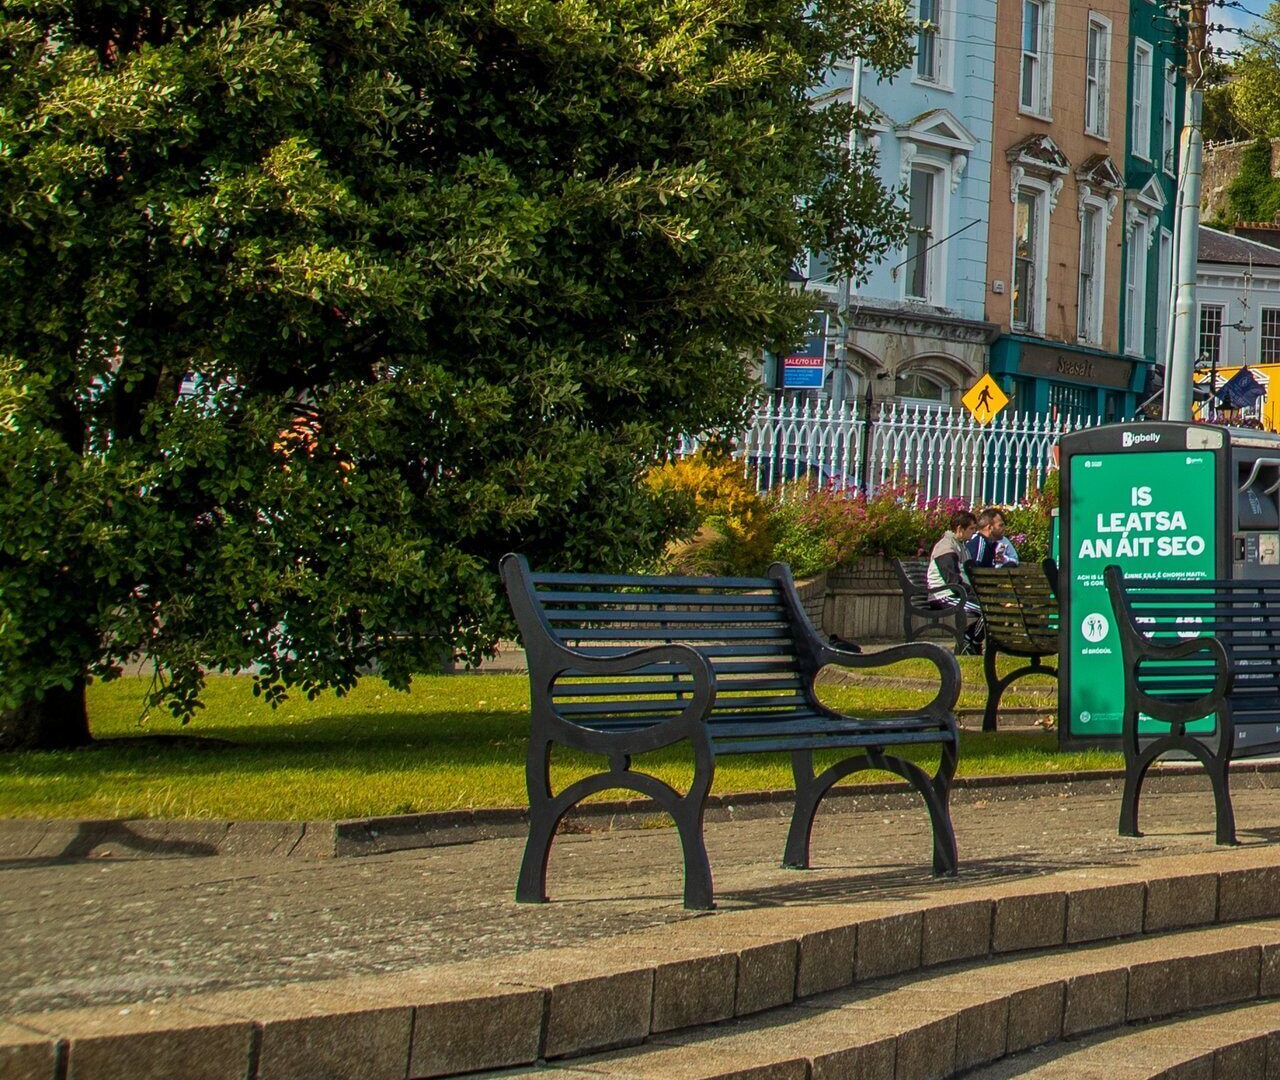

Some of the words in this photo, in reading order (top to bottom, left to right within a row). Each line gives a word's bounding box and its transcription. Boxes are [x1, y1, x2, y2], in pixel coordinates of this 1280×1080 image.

[1057, 355, 1095, 378] Seasalt
[1122, 431, 1160, 447] Bigbelly
[1131, 486, 1153, 507] IS
[1097, 511, 1188, 533] LEATSA
[1078, 538, 1113, 559] AN
[1115, 532, 1155, 557] ÁIT
[1157, 535, 1205, 557] SEO
